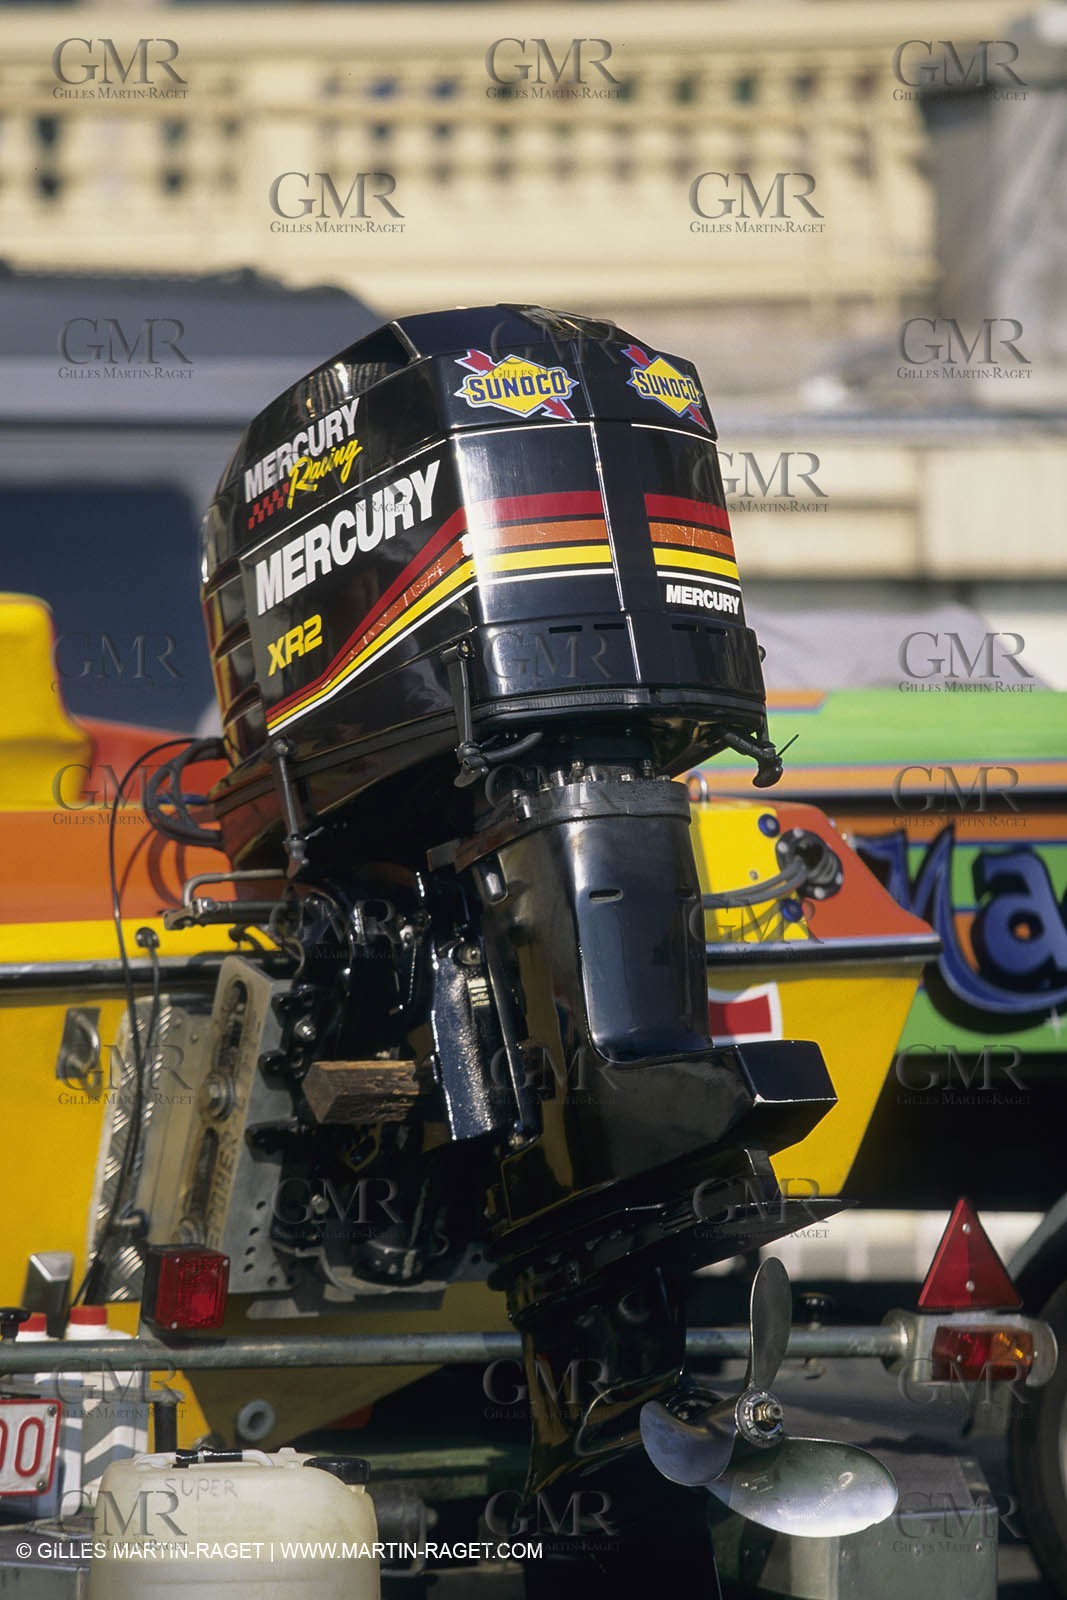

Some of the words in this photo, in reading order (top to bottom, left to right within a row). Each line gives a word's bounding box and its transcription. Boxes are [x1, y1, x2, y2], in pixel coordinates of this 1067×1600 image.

[468, 371, 567, 401] SUNOCO
[633, 371, 699, 403] SUNOCO
[244, 398, 360, 503] MERCURY
[287, 439, 363, 509] Racing
[255, 459, 441, 616] MERCURY
[665, 583, 741, 615] MERCURY
[266, 614, 323, 676] XR2
[163, 1477, 239, 1501] SUPER
